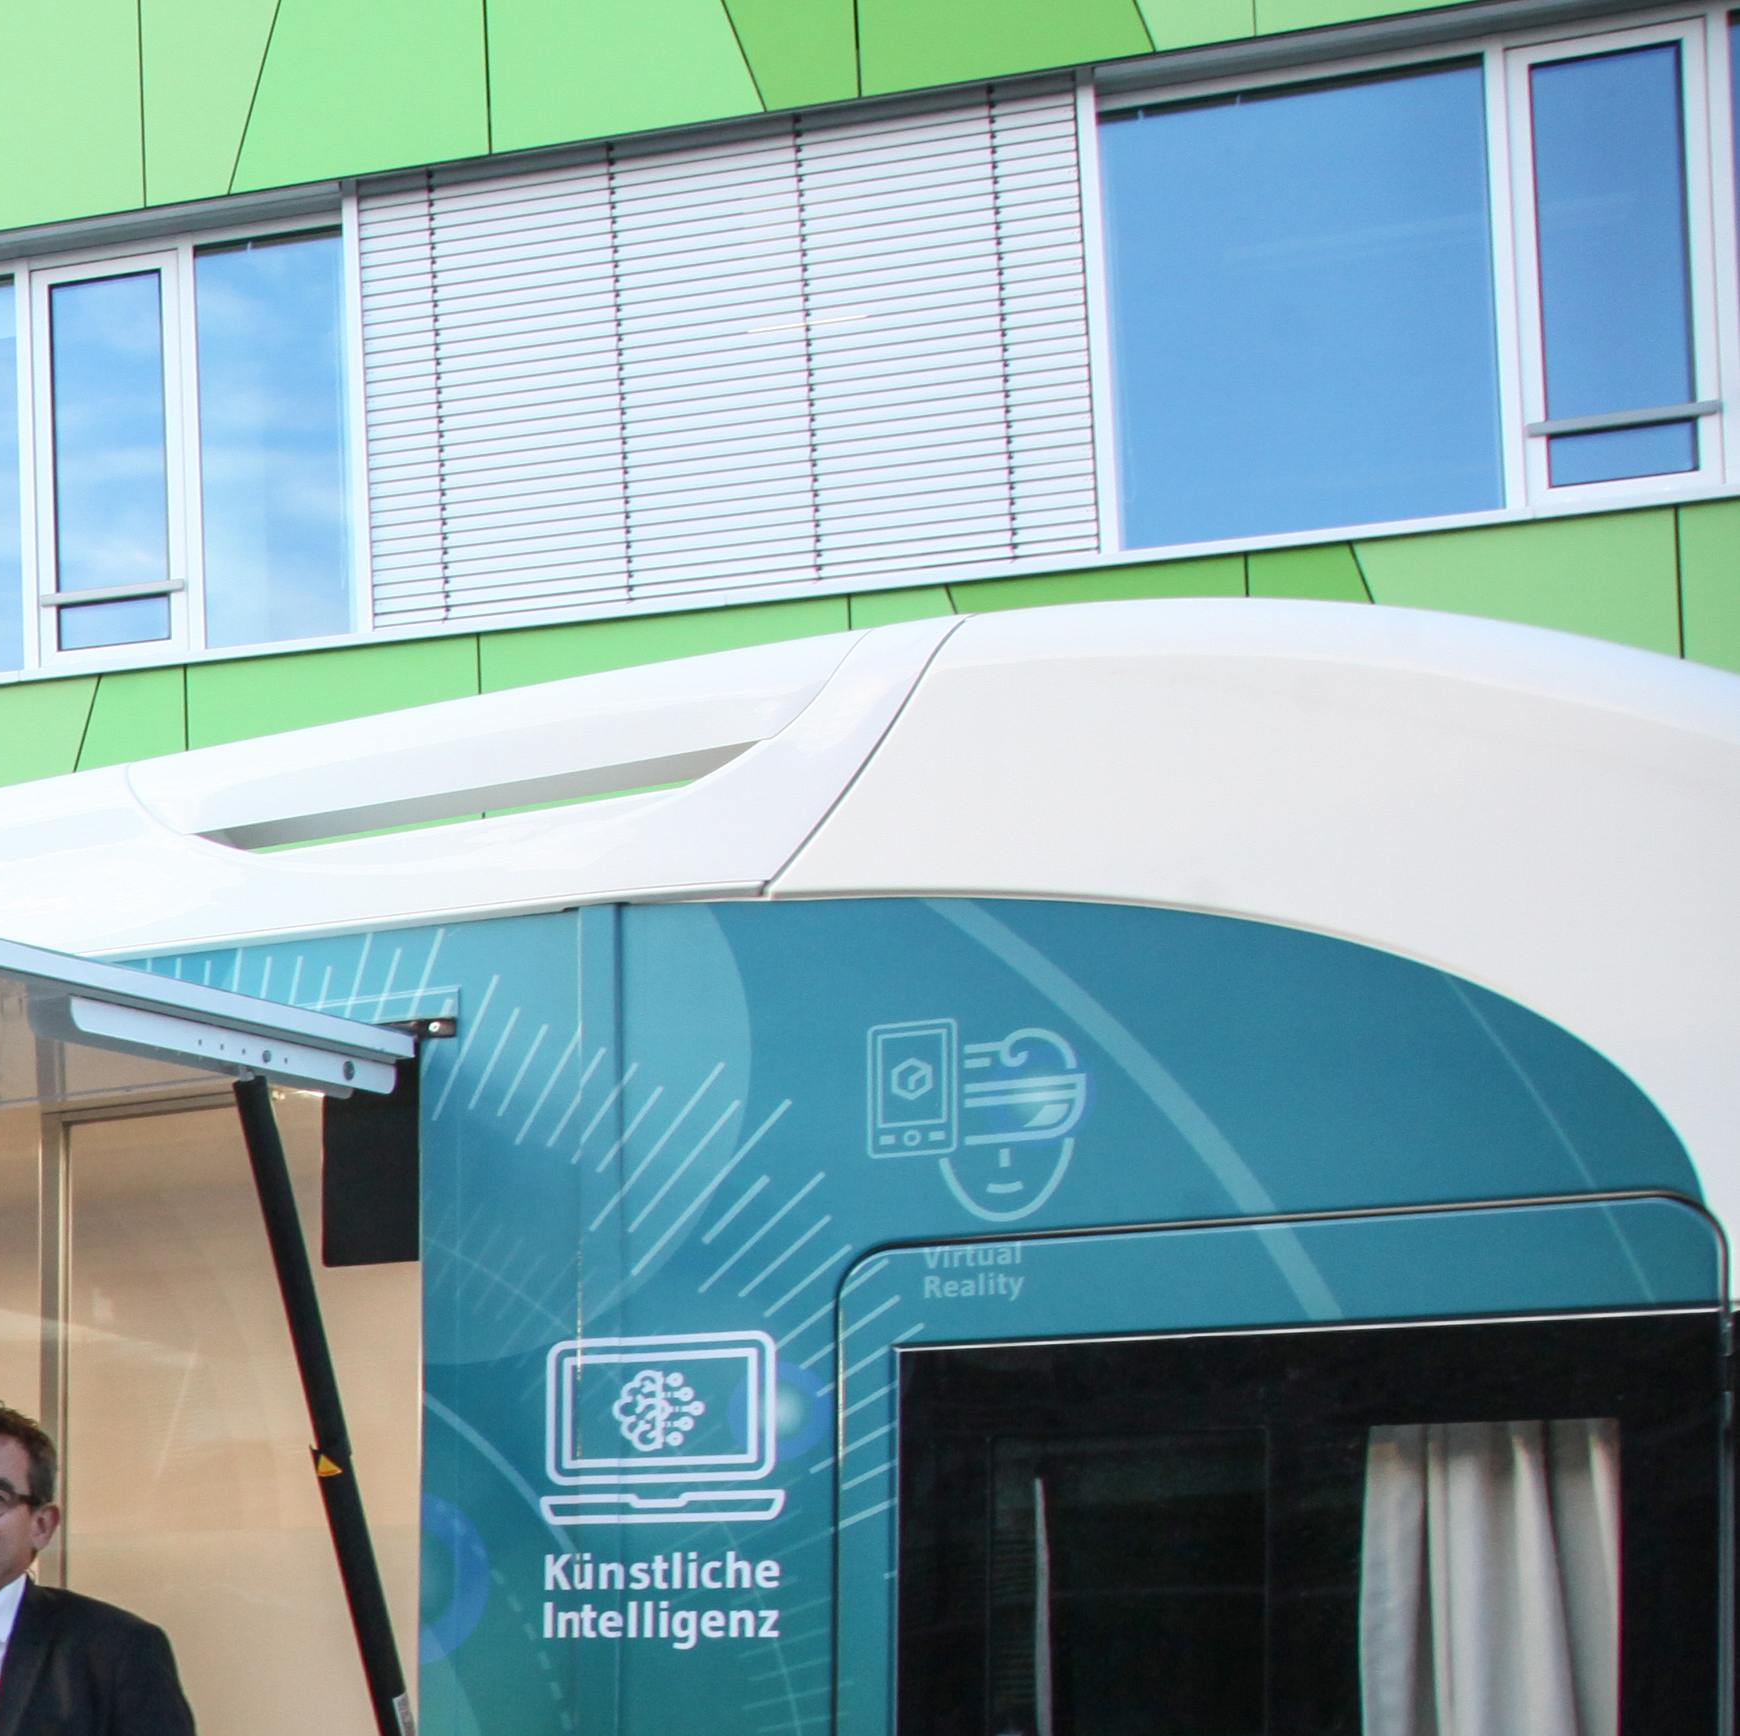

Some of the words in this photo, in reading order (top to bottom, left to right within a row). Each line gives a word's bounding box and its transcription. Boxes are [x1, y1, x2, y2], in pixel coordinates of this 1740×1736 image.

[922, 1241, 1024, 1269] Virtual
[923, 1272, 1025, 1302] Reality
[543, 1550, 781, 1591] Künstliche
[542, 1600, 781, 1651] Intelligenz
